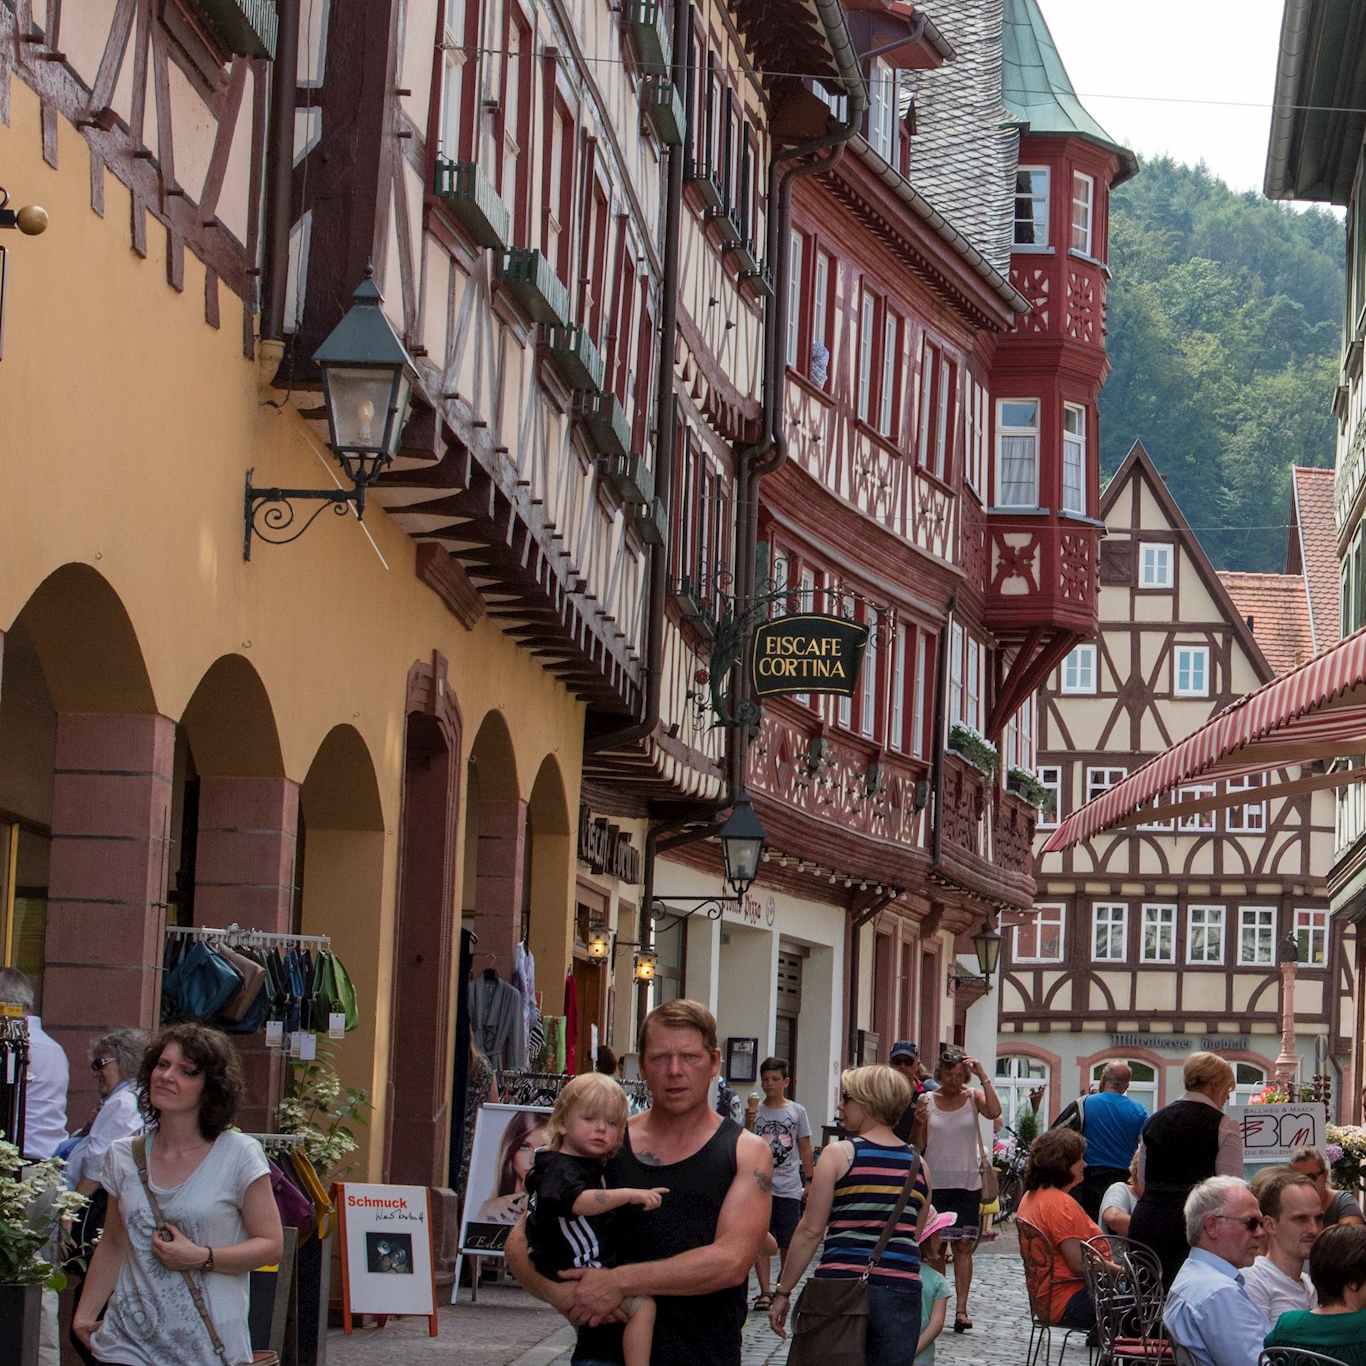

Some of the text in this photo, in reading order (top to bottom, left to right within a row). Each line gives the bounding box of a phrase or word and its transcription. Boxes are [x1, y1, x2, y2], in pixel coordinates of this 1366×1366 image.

[765, 636, 842, 657] EISCAFE
[758, 657, 846, 679] CORTINA
[1111, 1033, 1193, 1051] Miltenberger
[347, 1195, 408, 1209] Schmuck
